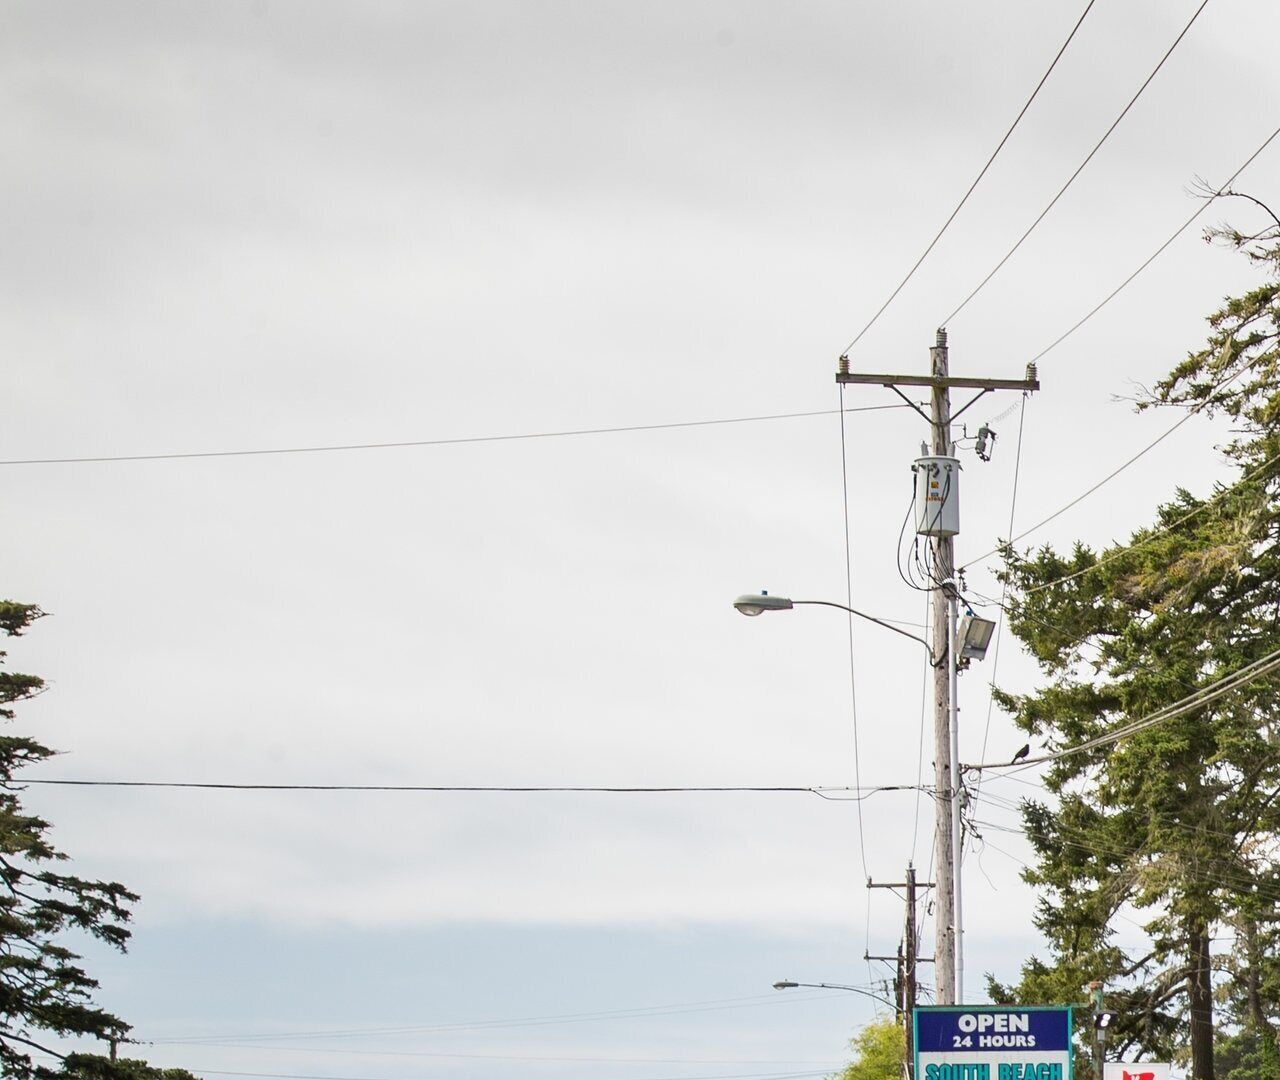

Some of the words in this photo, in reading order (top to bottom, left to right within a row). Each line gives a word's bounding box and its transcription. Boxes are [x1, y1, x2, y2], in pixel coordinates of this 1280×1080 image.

[958, 1014, 1029, 1033] OPEN
[953, 1036, 973, 1048] 24
[980, 1035, 1036, 1047] HOURS
